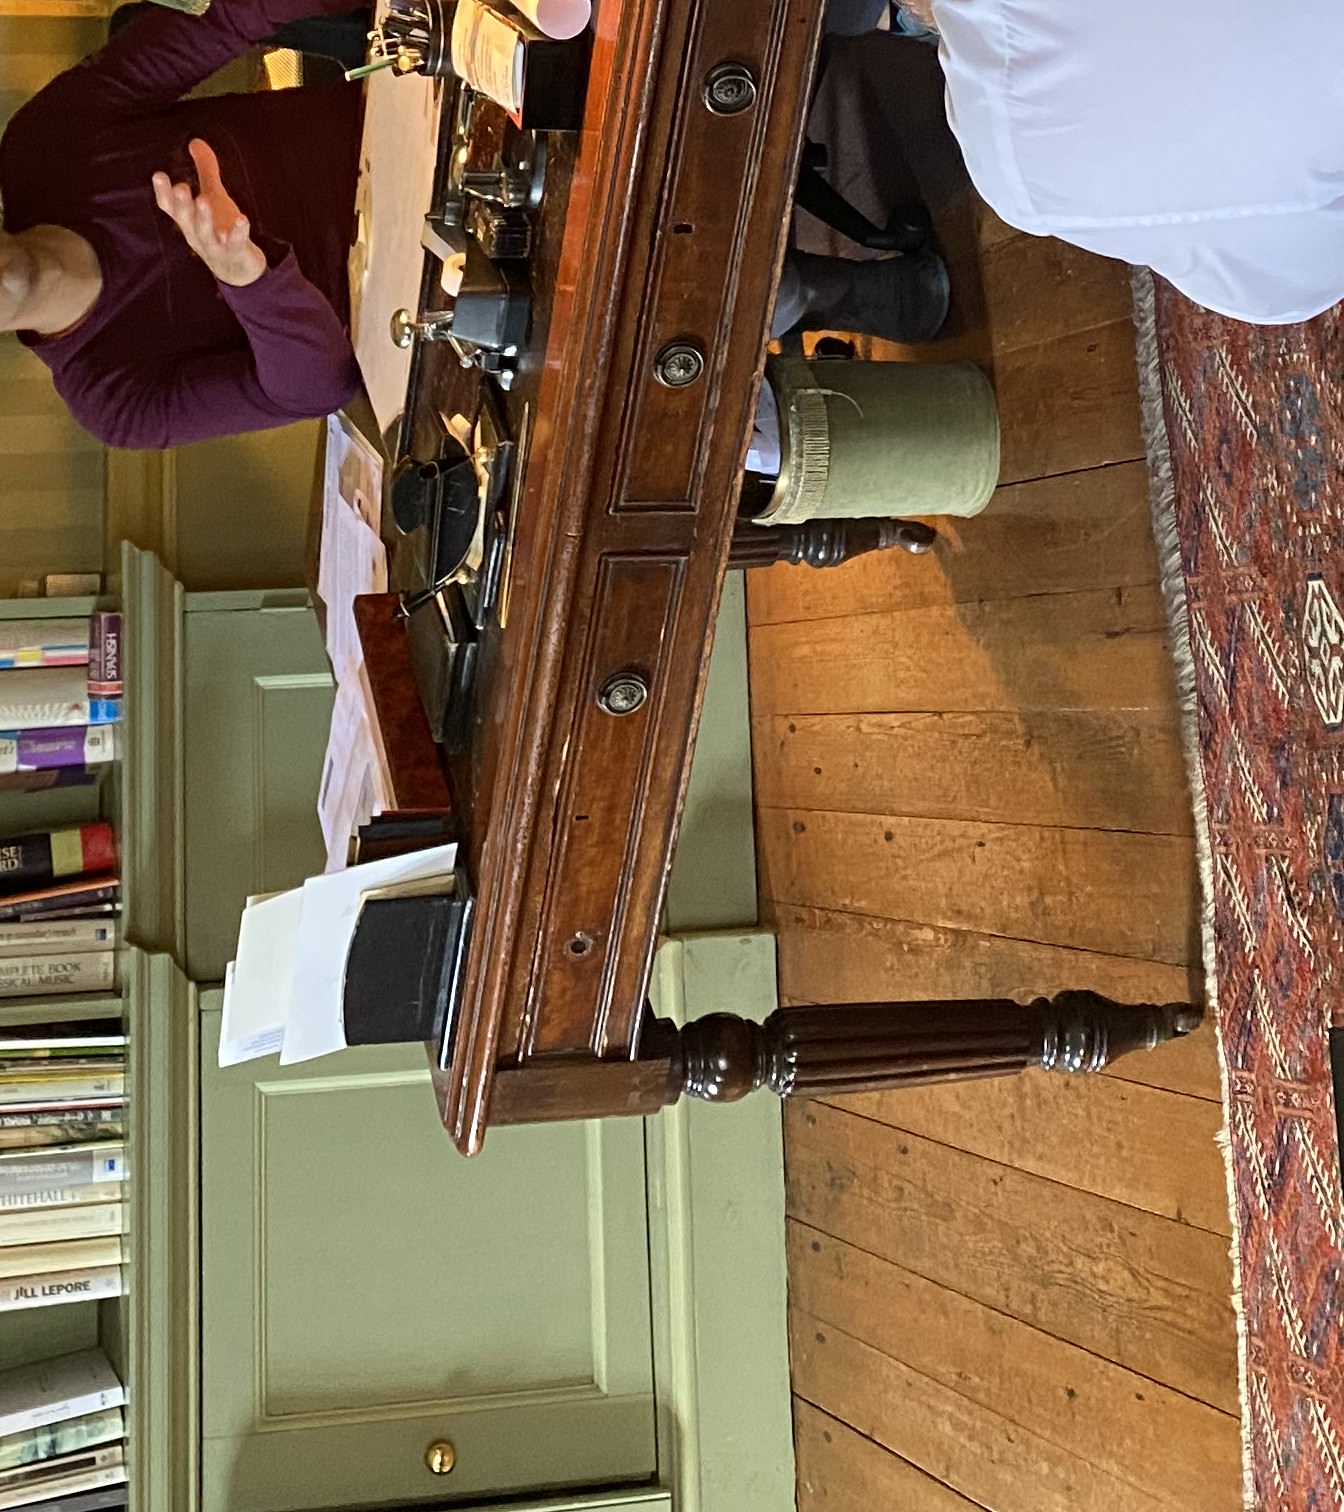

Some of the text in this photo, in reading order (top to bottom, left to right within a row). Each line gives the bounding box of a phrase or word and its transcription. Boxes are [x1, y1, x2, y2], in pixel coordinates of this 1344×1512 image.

[48, 962, 81, 975] BOOK
[37, 974, 76, 986] MUSIC
[41, 1280, 91, 1296] LEPORE
